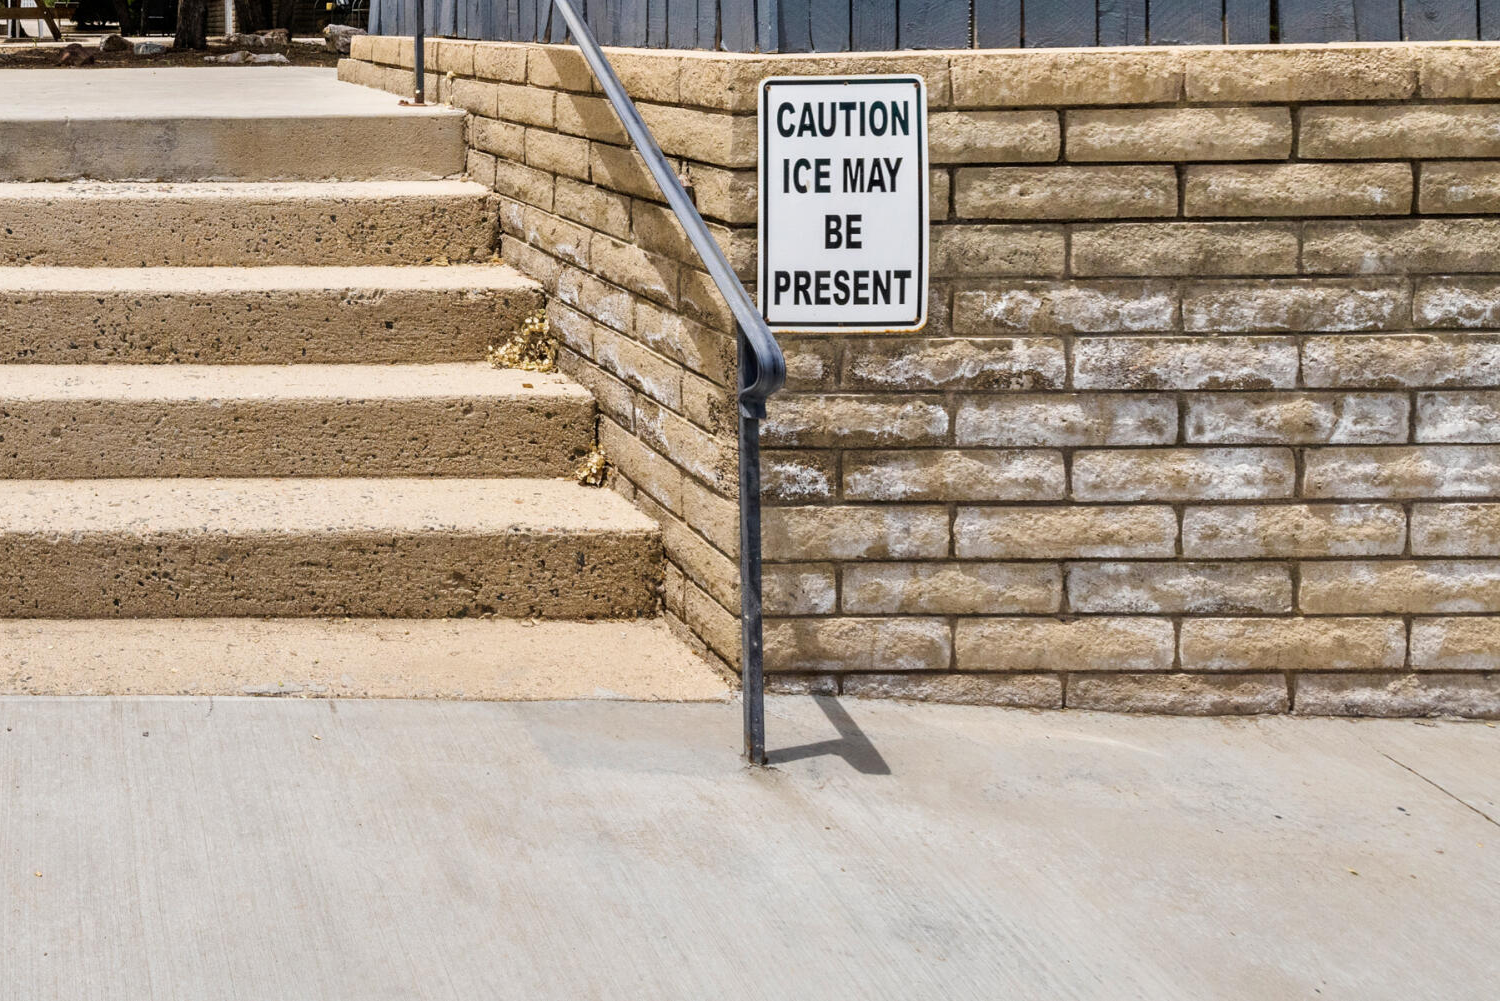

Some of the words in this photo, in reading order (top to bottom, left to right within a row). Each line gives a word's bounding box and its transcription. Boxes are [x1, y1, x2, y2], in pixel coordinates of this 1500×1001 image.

[776, 100, 910, 138] CAUTION
[783, 157, 831, 194] ICE
[842, 157, 904, 194] MAY
[824, 213, 863, 250] BE
[774, 269, 912, 306] PRESENT
